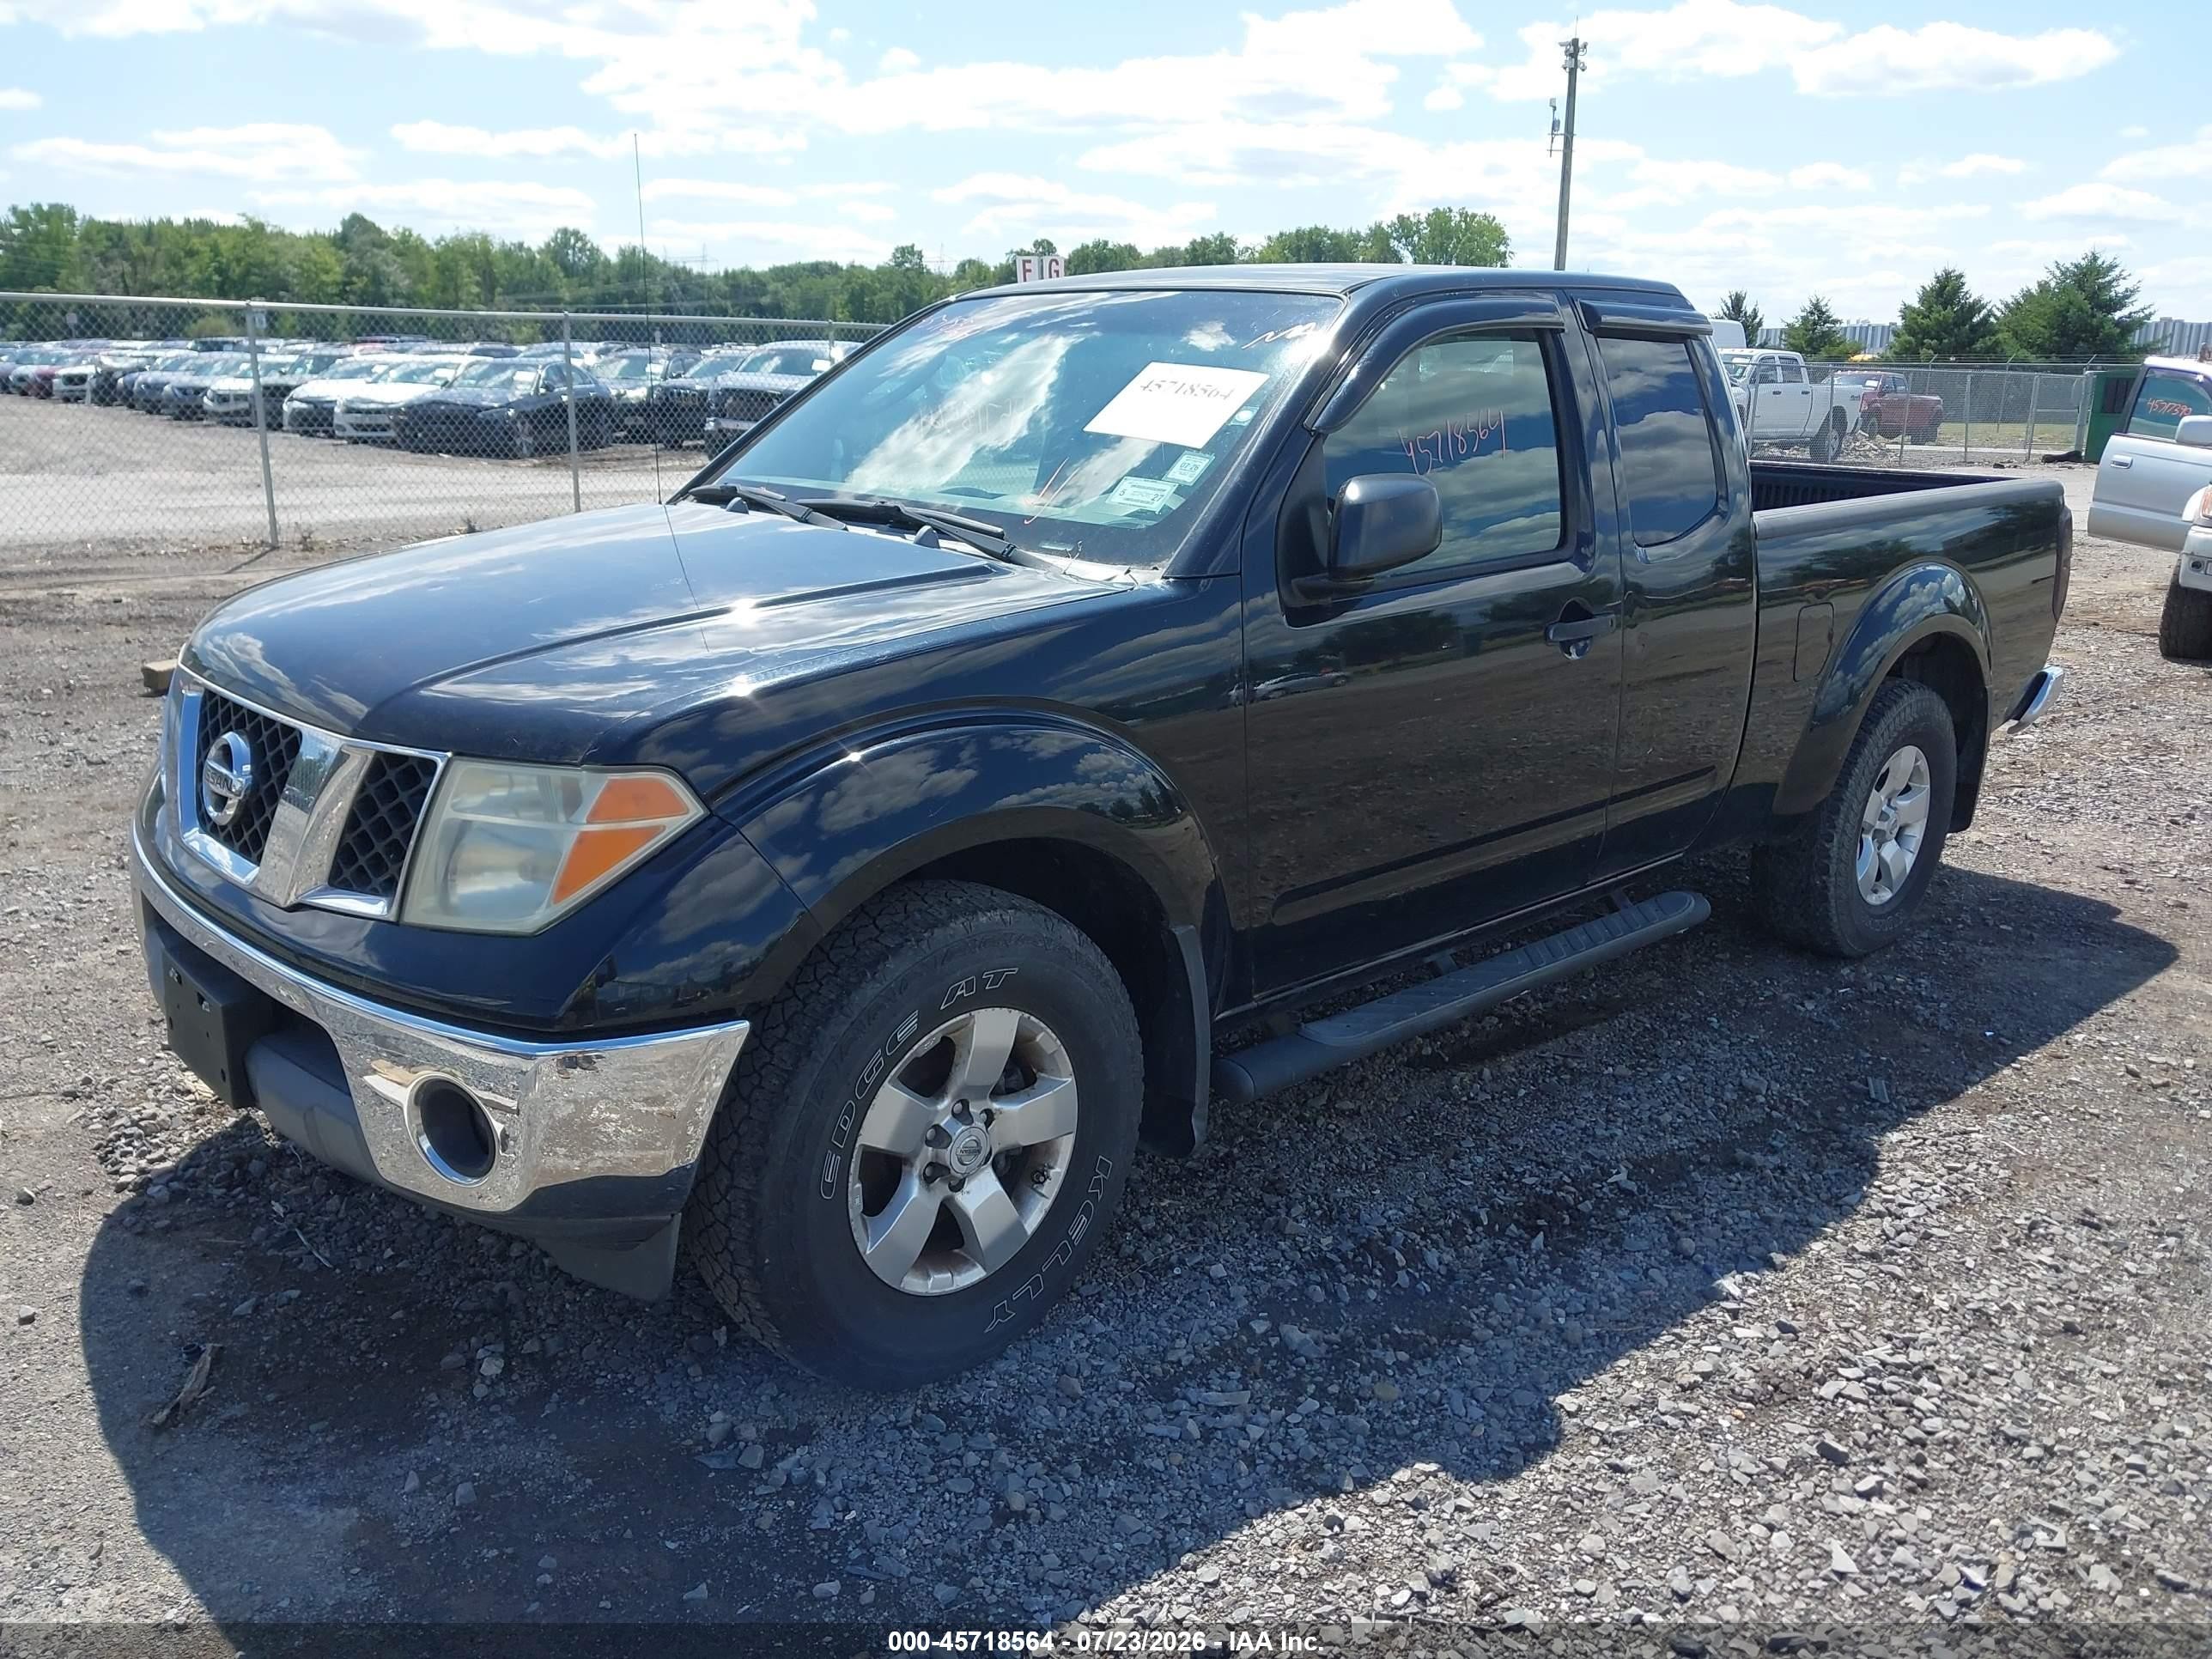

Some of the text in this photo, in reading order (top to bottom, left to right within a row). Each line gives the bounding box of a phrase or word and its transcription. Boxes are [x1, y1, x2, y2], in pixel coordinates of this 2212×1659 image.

[820, 967, 1019, 1200] EDGE AT
[984, 1155, 1113, 1333] KELLY
